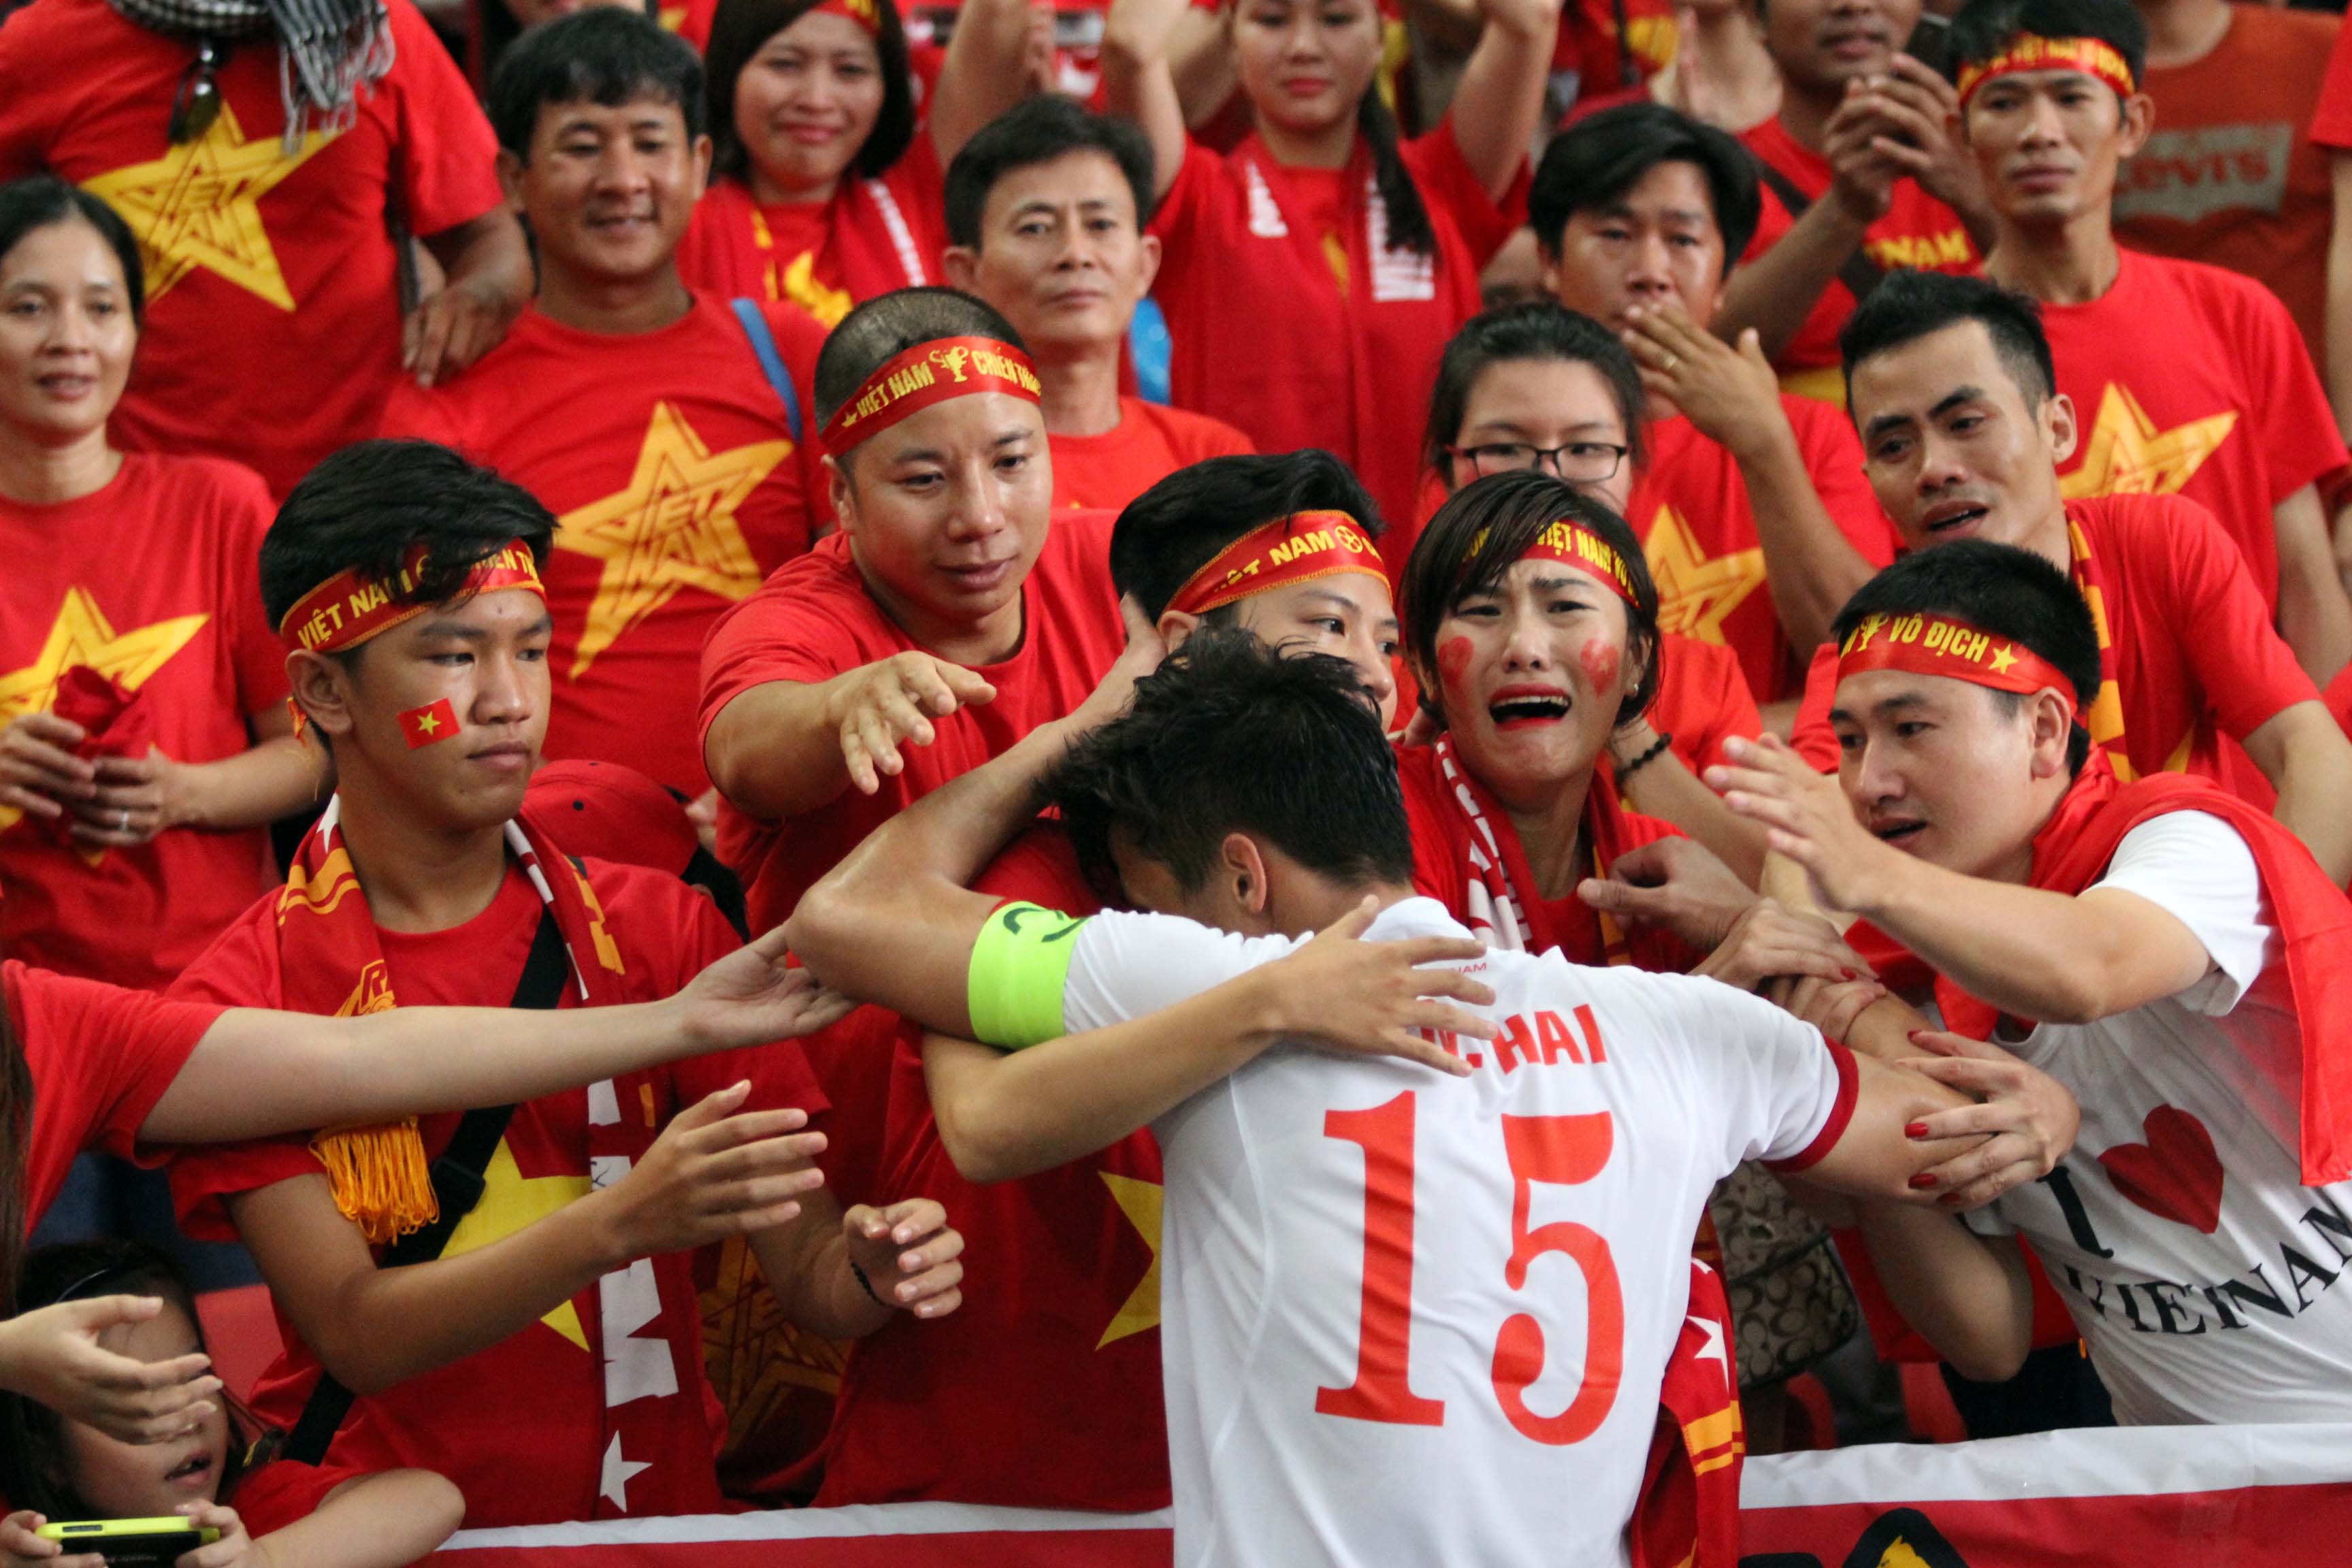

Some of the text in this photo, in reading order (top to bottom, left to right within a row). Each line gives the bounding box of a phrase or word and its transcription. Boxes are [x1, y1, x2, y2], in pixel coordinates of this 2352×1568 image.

[887, 361, 935, 399] NAM
[1269, 530, 1336, 566] NAM
[297, 603, 342, 651] VIỆT
[1889, 612, 1923, 644] VÔ
[1923, 621, 1991, 664] ĐỊCH
[1315, 1090, 1624, 1446] 15
